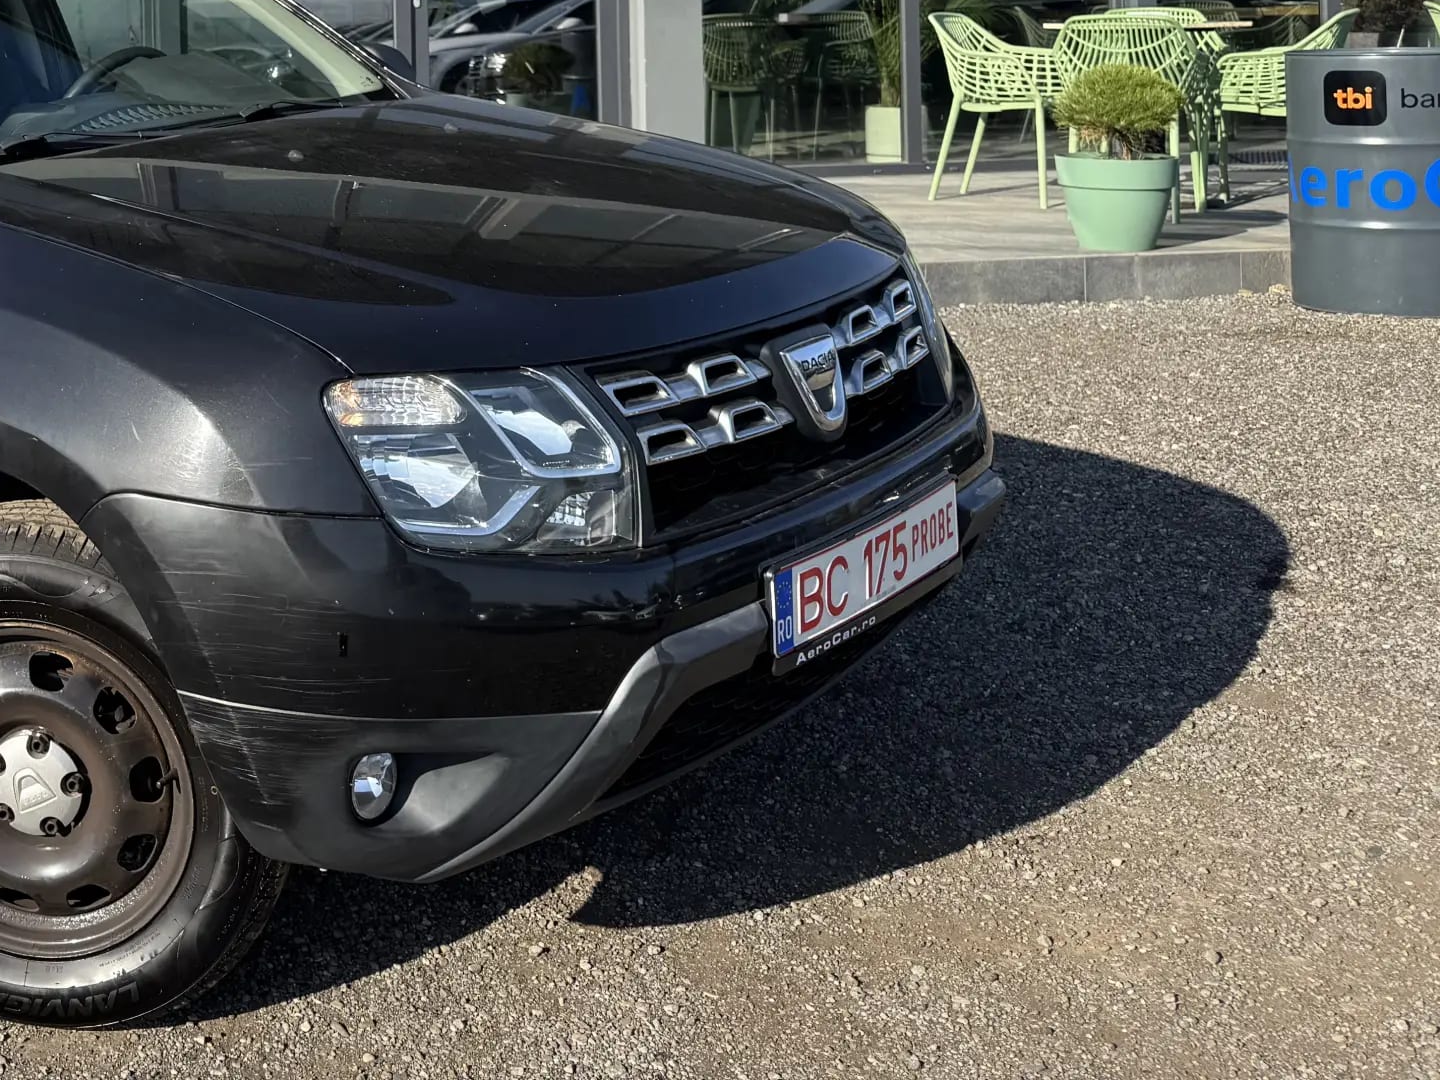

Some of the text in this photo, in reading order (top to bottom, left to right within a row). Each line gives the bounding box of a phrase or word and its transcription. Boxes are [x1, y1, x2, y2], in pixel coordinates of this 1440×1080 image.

[1334, 87, 1440, 110] tbi ba
[801, 350, 835, 372] DACIA
[778, 502, 954, 645] RO BC 175 PROBE
[796, 615, 876, 666] AeroCar.ro
